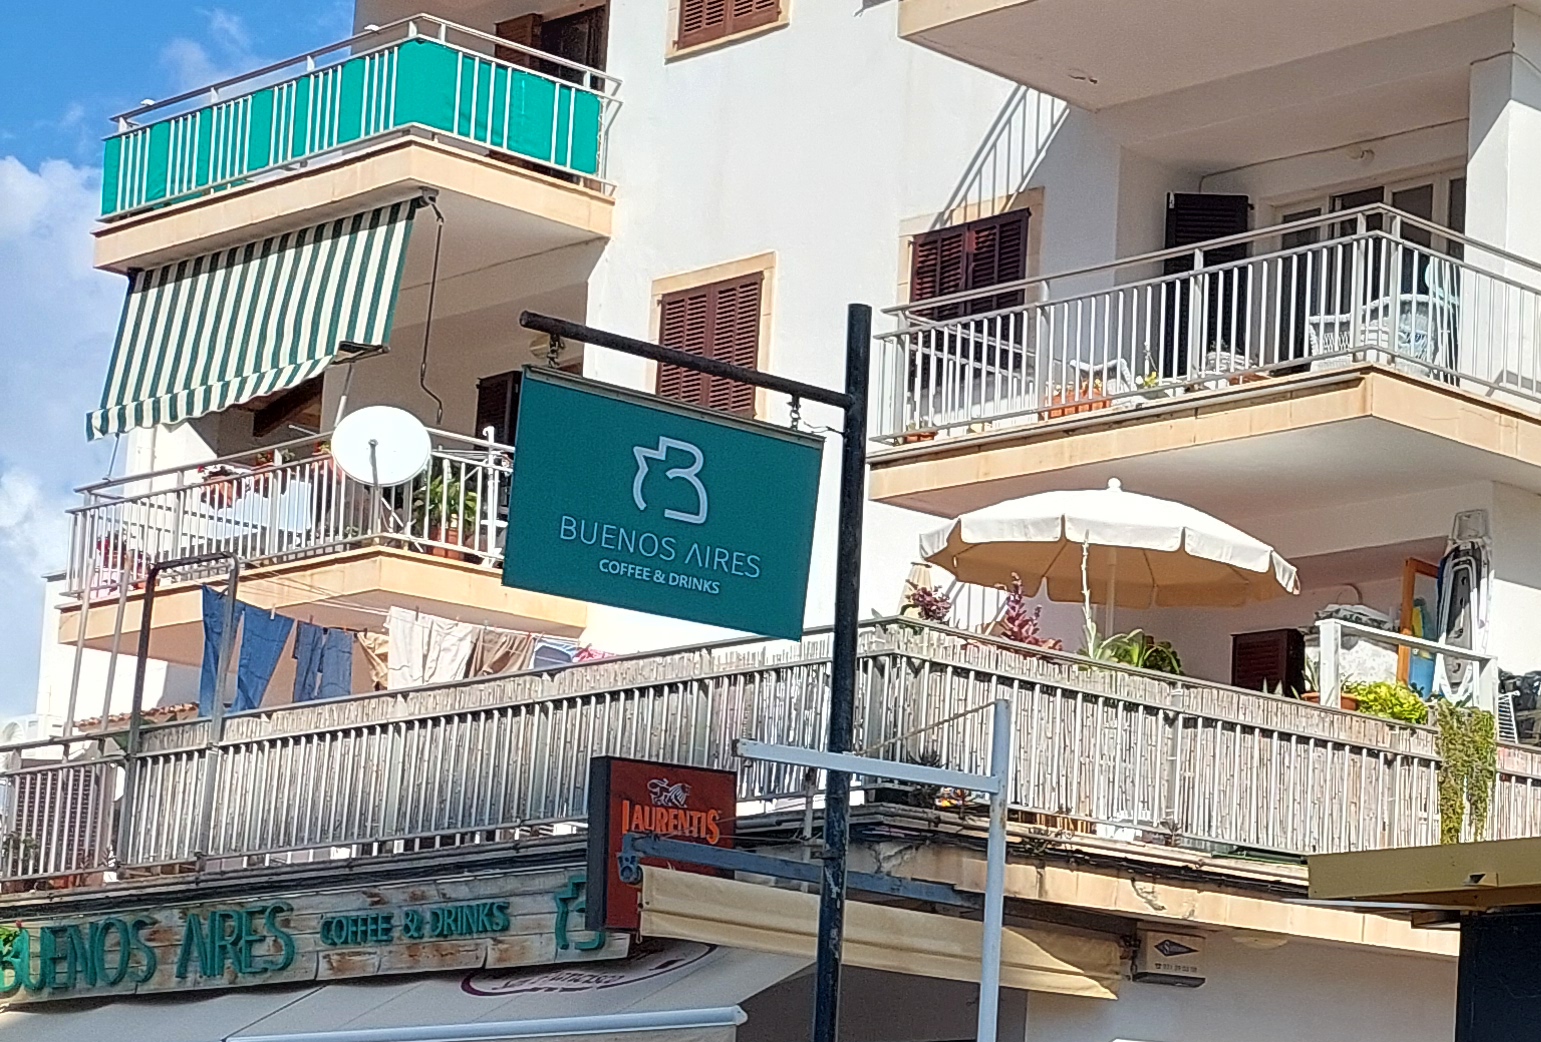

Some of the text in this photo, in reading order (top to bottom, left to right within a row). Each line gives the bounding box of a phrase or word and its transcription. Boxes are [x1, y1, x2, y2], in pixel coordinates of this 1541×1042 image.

[559, 515, 761, 579] BUENOS AIRES
[599, 558, 721, 594] COFFEE & DRINKS
[0, 901, 295, 992] BUENOS AIRES
[320, 900, 511, 947] COFFEE & DRINKS
